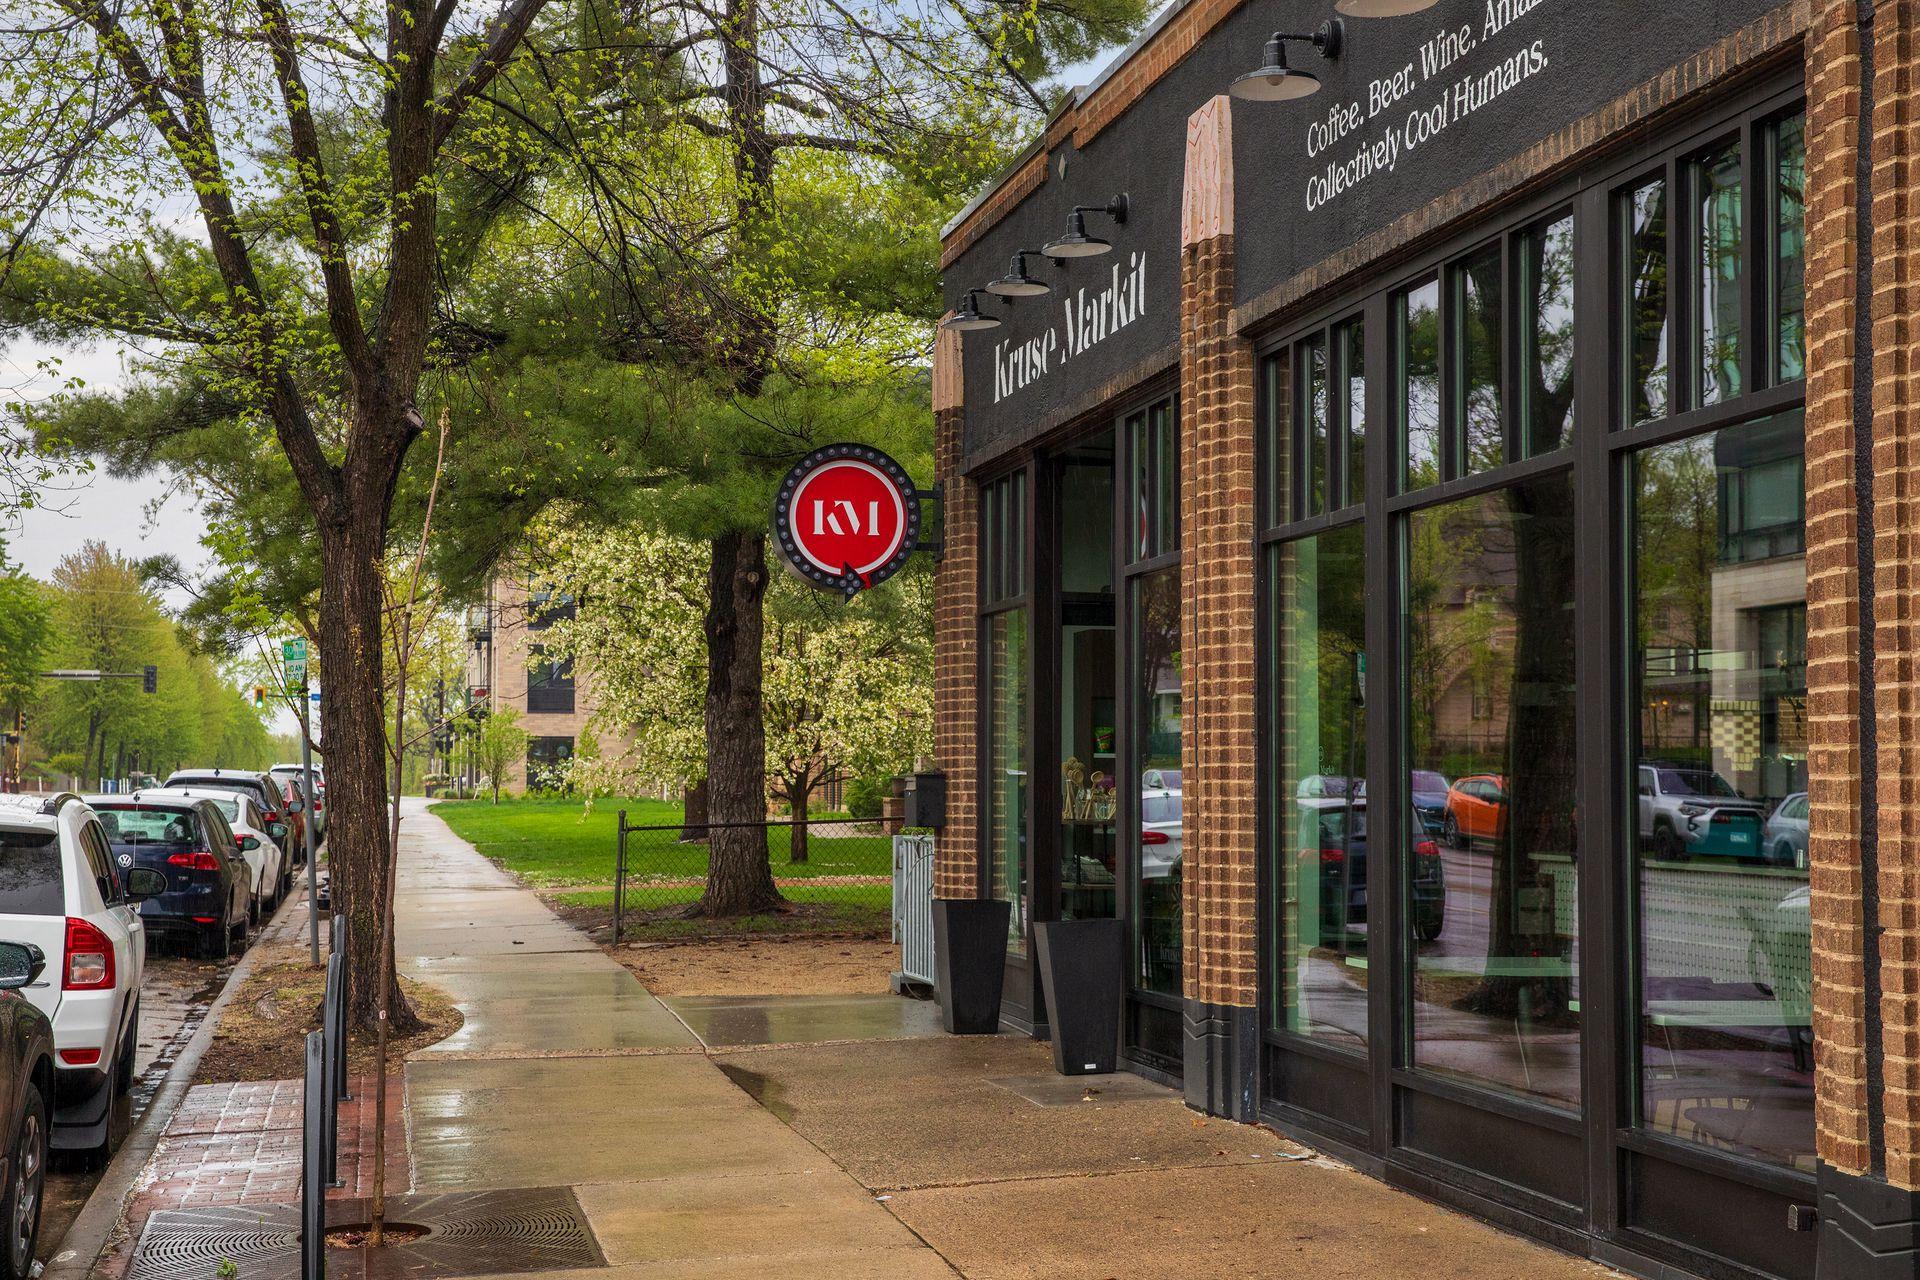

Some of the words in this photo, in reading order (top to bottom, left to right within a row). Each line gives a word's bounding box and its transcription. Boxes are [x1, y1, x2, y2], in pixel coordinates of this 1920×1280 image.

[1306, 126, 1400, 211] Collectively
[1405, 88, 1449, 150] Cool
[1453, 39, 1548, 122] Humans.
[1307, 103, 1364, 157] Coffee.
[1368, 63, 1415, 118] Beer.
[1420, 24, 1477, 80] Wine.
[994, 327, 1056, 403] Kruse
[1060, 251, 1146, 365] Markit
[812, 499, 881, 536] KM
